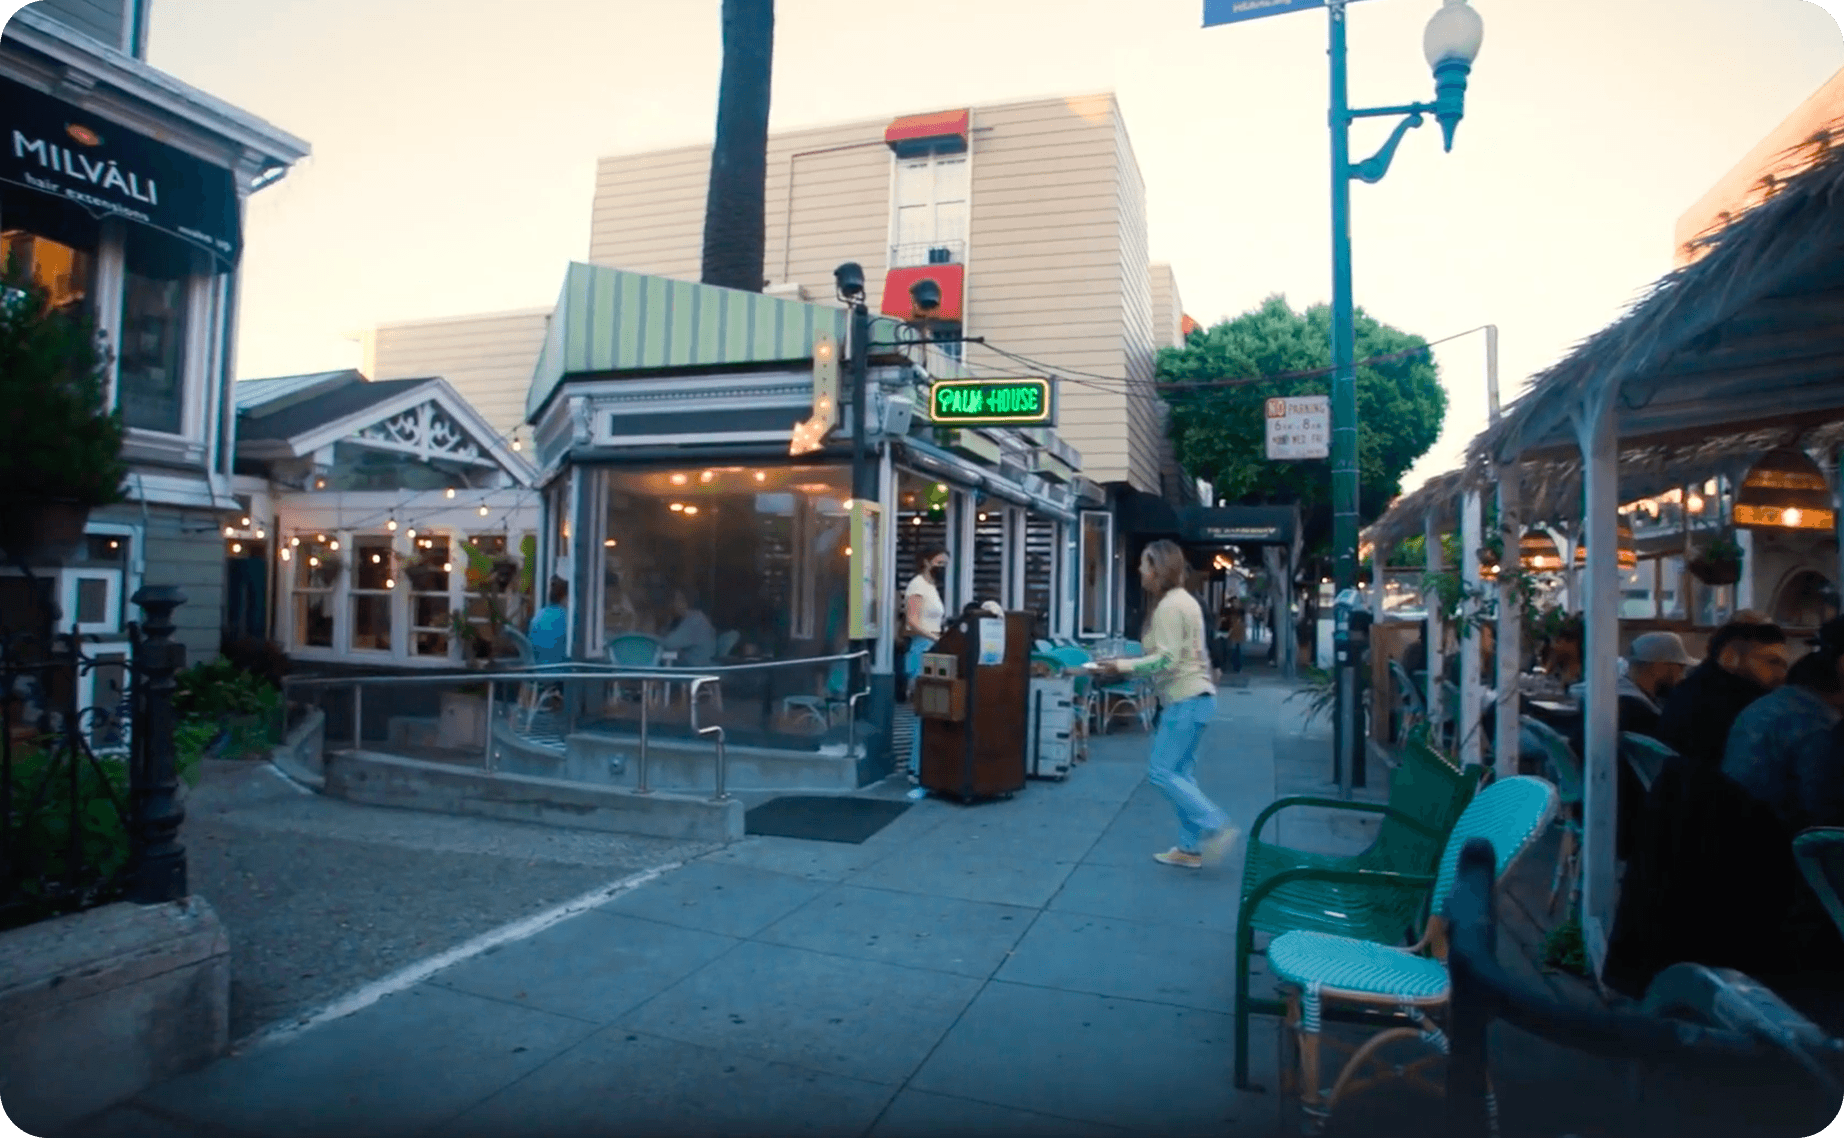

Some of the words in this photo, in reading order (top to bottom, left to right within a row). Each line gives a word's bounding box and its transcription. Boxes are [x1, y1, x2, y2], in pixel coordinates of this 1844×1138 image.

[23, 171, 60, 193] hair
[65, 187, 150, 222] extensions
[937, 388, 983, 413] PALM
[986, 387, 1038, 413] HOUSE
[1268, 400, 1285, 416] NO
